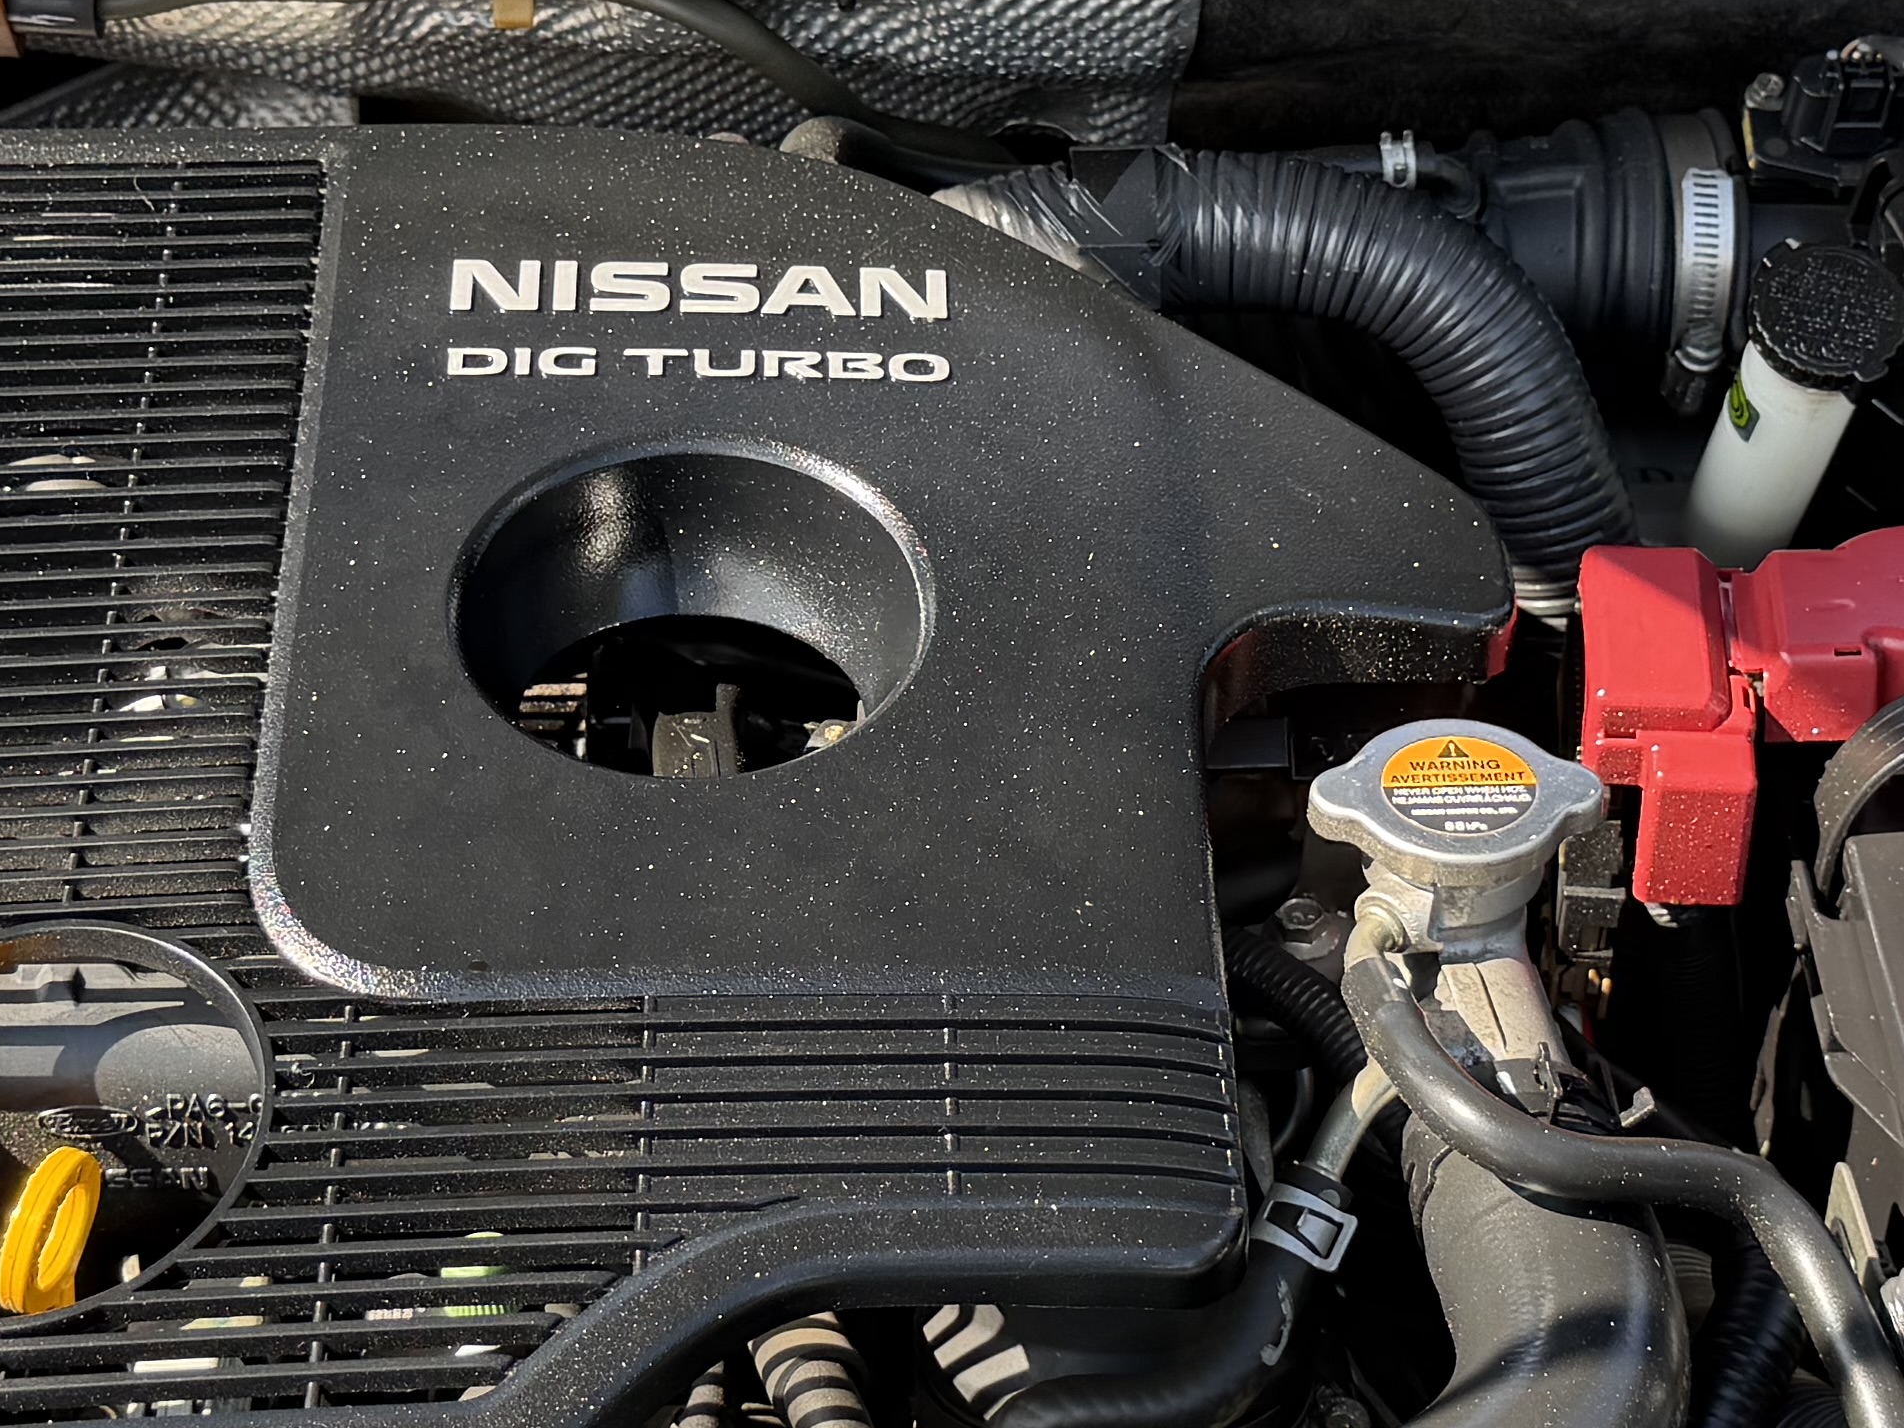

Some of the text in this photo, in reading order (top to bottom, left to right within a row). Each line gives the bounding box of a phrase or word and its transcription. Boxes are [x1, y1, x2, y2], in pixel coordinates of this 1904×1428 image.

[448, 259, 948, 321] NISSAN
[447, 347, 951, 383] DIG TURBO
[1409, 759, 1501, 771] WARNING
[1390, 771, 1525, 784] AVERTISSEMENT
